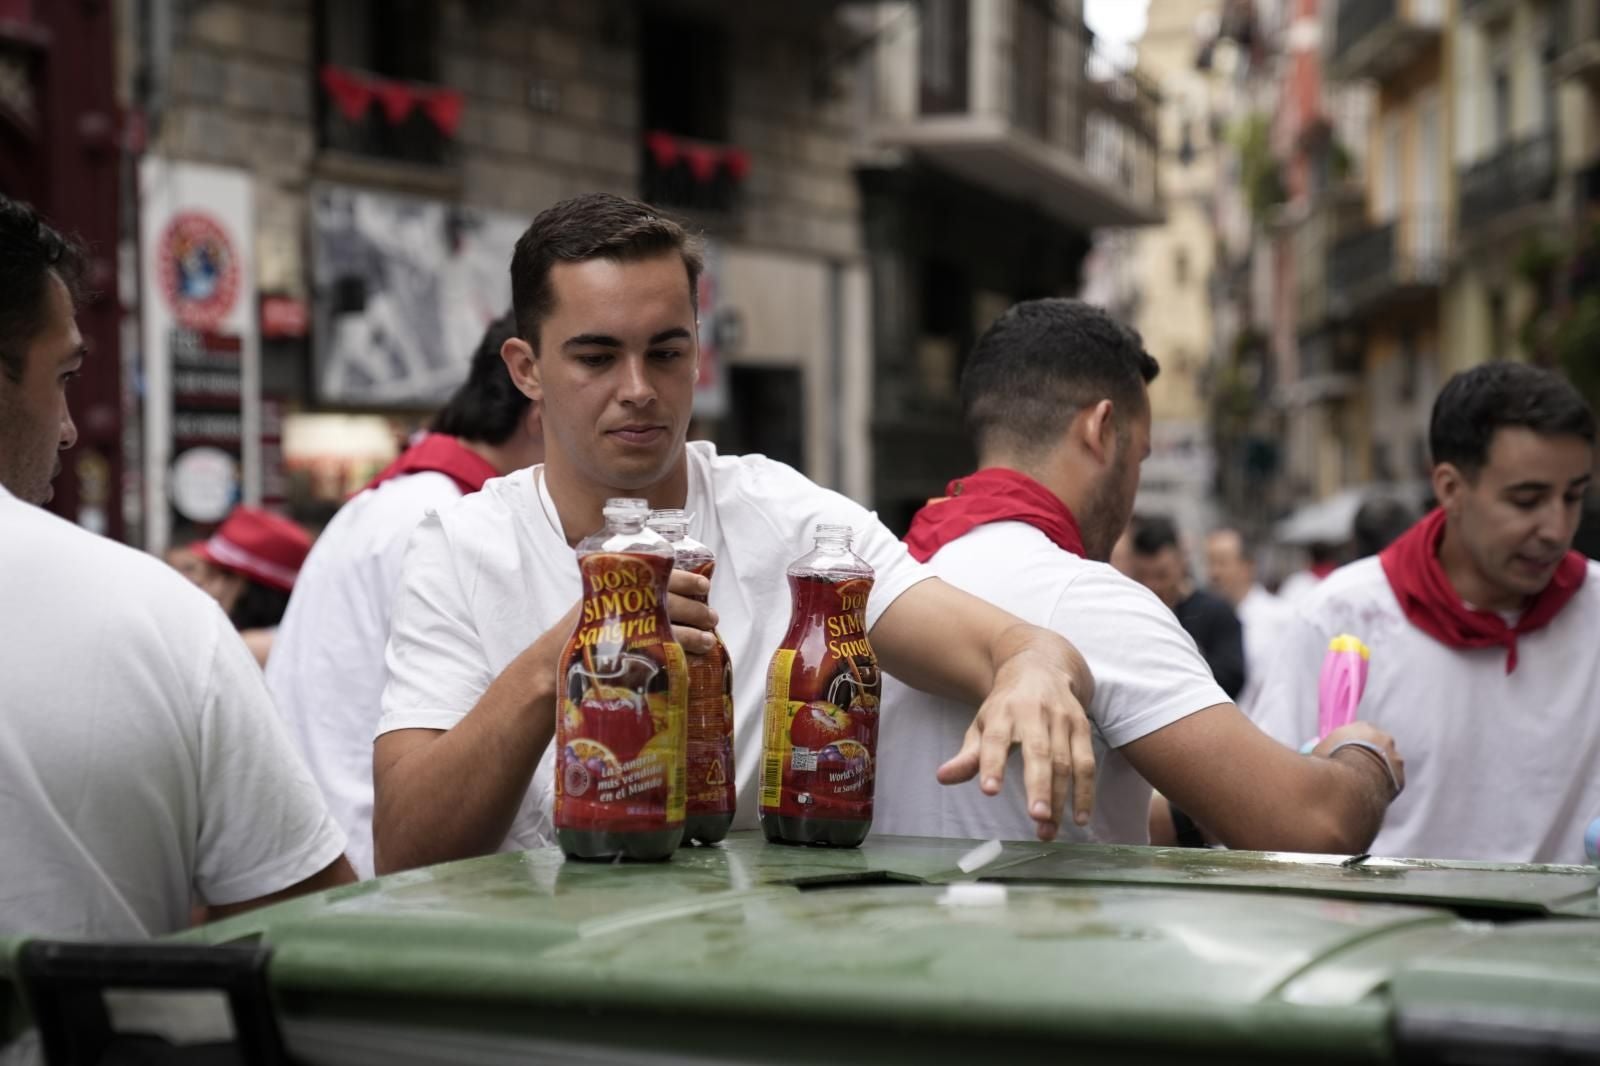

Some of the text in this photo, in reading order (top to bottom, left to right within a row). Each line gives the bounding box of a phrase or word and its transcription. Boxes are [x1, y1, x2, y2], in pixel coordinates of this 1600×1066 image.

[590, 568, 639, 592] DON
[584, 587, 659, 623] SIMON
[575, 611, 657, 649] Sangria
[601, 754, 657, 778] La Sangria
[599, 777, 664, 802] en el Mundo
